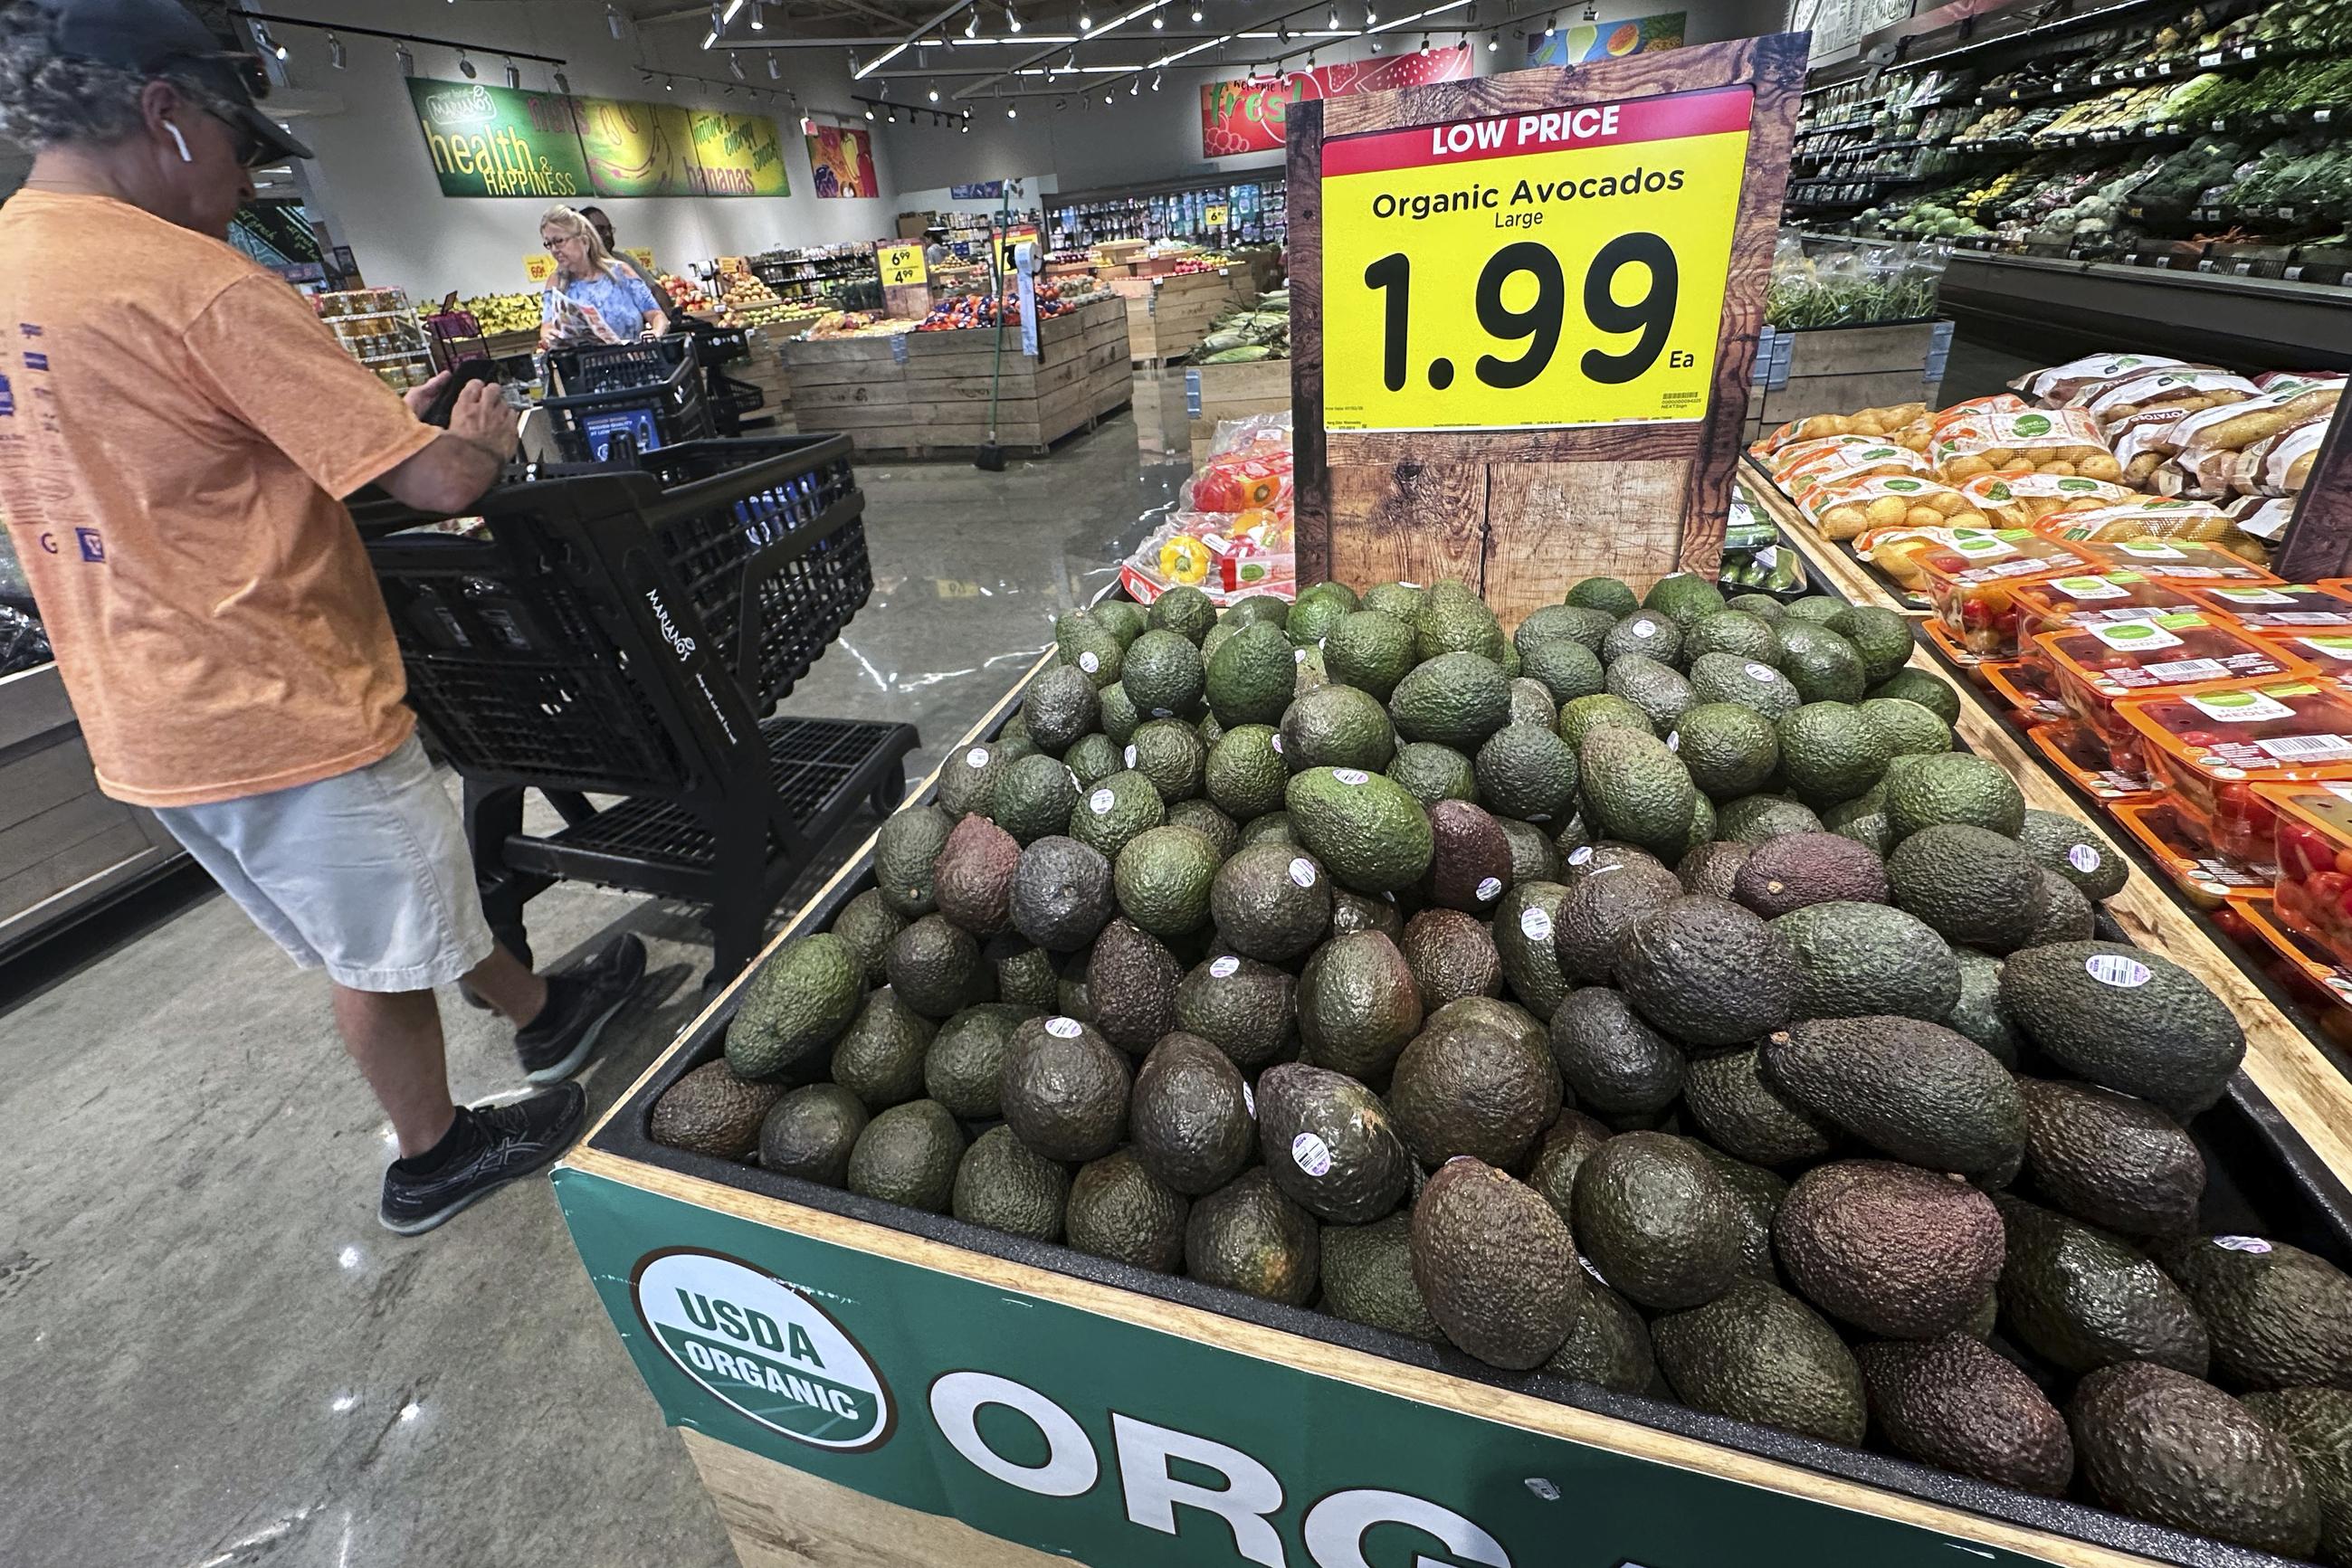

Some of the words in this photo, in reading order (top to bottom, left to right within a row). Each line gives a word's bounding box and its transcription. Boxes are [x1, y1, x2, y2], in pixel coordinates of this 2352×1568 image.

[423, 119, 534, 174] health
[1433, 119, 1509, 155] LOW
[1518, 105, 1620, 145] PRICE
[483, 170, 576, 195] HAPPINESS
[1372, 185, 1500, 220] Organic
[1510, 166, 1685, 205] Avocados
[1495, 210, 1544, 229] Large
[1364, 232, 1680, 393] 1.99
[1670, 351, 1694, 369] Ea
[675, 1287, 826, 1370] USDA
[684, 1340, 860, 1421] ORGANIC
[929, 1369, 1643, 1568] ORG
